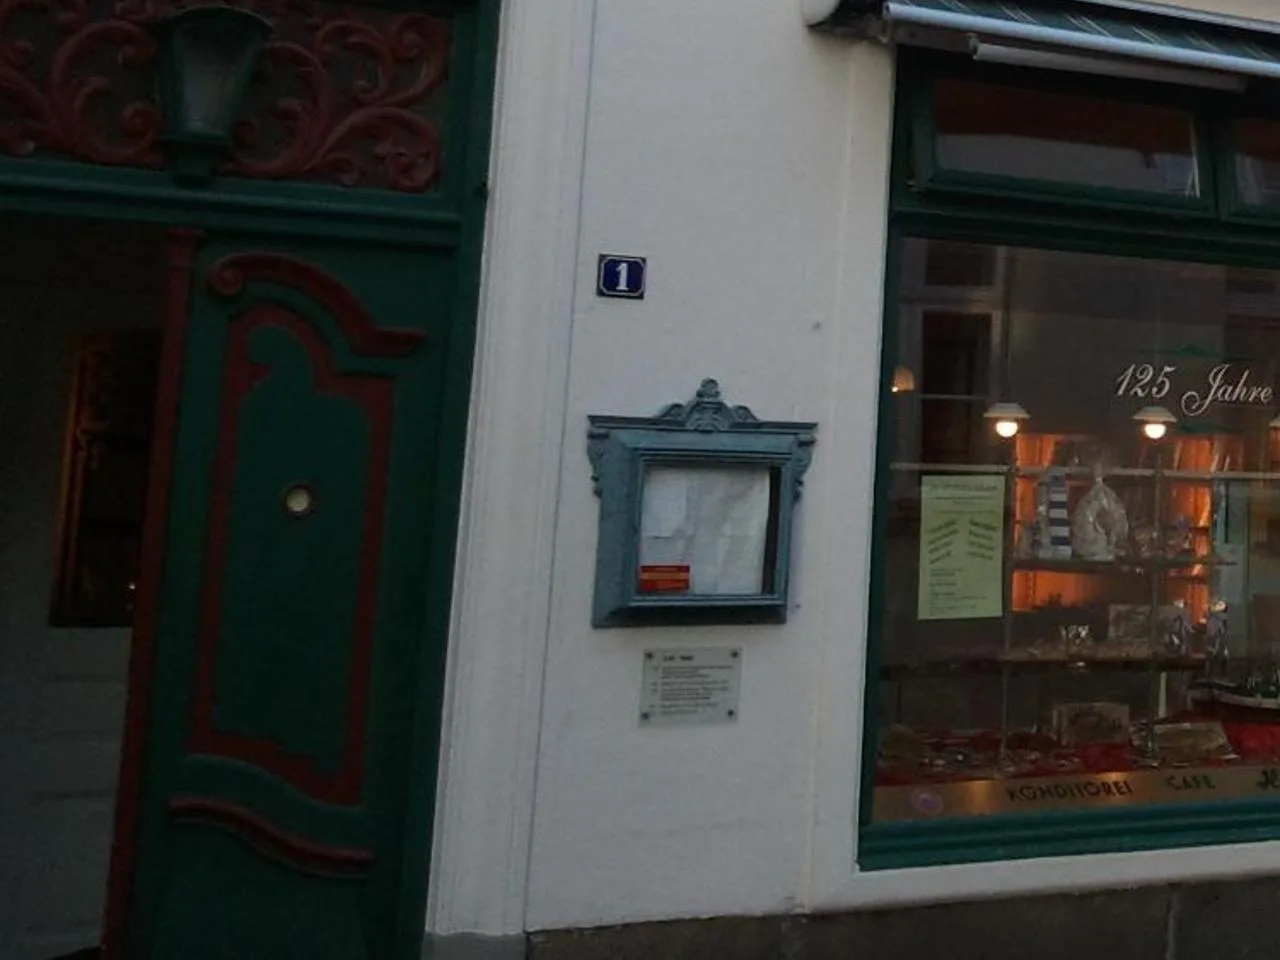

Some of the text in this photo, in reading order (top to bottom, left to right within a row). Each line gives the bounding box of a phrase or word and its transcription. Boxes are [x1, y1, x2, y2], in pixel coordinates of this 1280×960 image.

[615, 262, 629, 290] 1
[1115, 363, 1274, 417] 125 Jahre
